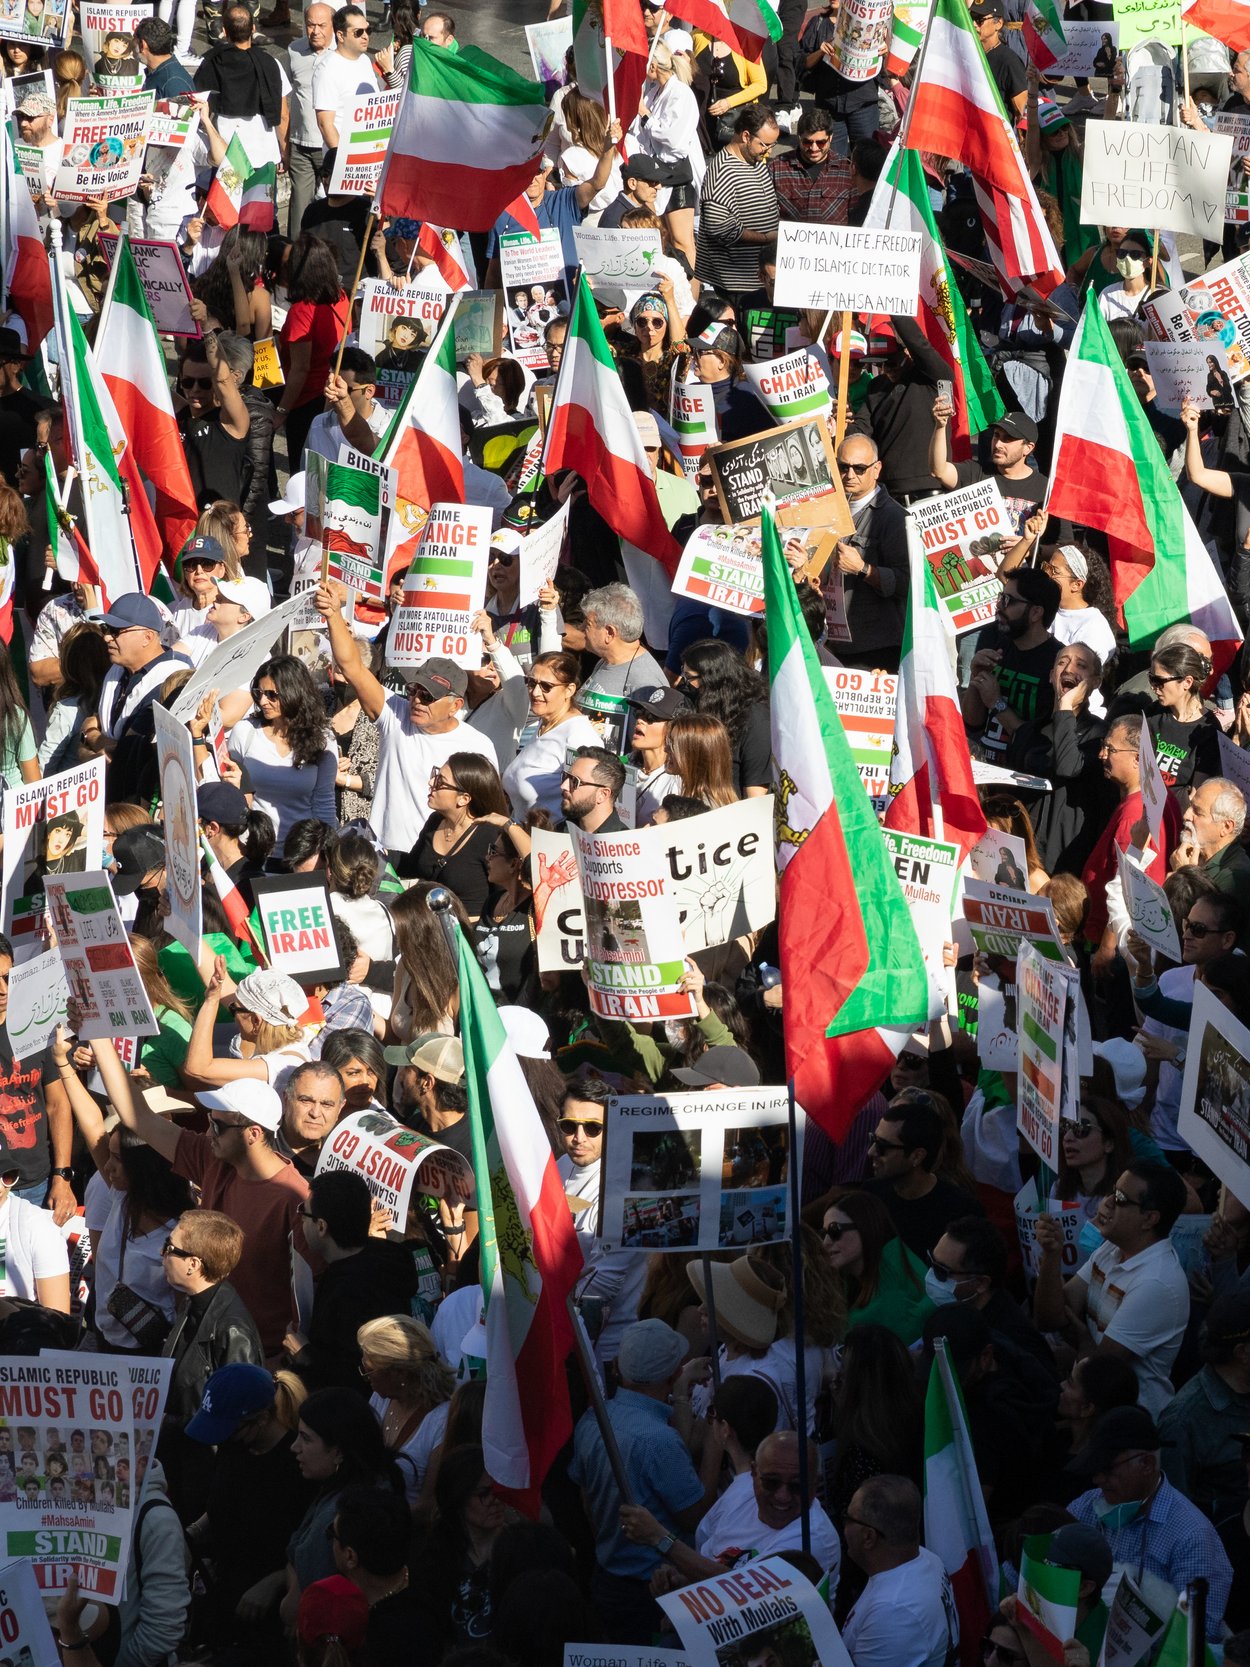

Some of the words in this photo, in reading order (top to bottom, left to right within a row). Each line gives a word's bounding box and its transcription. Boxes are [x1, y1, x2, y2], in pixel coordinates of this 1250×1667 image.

[87, 7, 112, 17] ISLAMIC
[115, 8, 148, 17] REPUBLIC
[87, 15, 126, 31] MUST
[99, 75, 137, 87] STAND
[72, 126, 107, 144] FREE
[108, 120, 145, 138] TOOMAJ
[1103, 129, 1210, 170] WOMAN
[76, 168, 89, 181] Be
[91, 166, 105, 180] His
[107, 162, 129, 177] Voice
[1124, 160, 1180, 187] LIFE
[1092, 181, 1196, 218] FREDOM
[604, 234, 618, 242] Life.
[875, 235, 921, 260] FREEDOM
[780, 256, 795, 276] NO
[798, 256, 812, 276] TO
[813, 257, 860, 274] ISLAMIC
[862, 259, 911, 278] DICTATOR
[374, 285, 403, 298] ISLAMIC
[406, 289, 442, 302] REPUBLIC
[1208, 276, 1245, 320] FREE
[370, 295, 416, 317] MUST
[421, 300, 443, 321] GO
[760, 358, 824, 396] CHANGE
[771, 354, 809, 376] REGIME
[779, 394, 785, 404] in
[793, 383, 816, 399] IRAN
[728, 467, 763, 488] STAND
[920, 499, 945, 519] MORE
[944, 483, 994, 510] AYATOLLAHS
[953, 495, 994, 522] REPUBLIC
[920, 522, 968, 554] MUST
[976, 508, 1000, 530] GO
[188, 538, 212, 551] USA
[427, 544, 458, 558] IRAN
[706, 538, 730, 555] Children
[729, 544, 746, 560] Killed
[340, 557, 371, 579] STAND
[717, 554, 758, 574] #MahsaAmini
[341, 570, 367, 590] IRAN
[708, 562, 764, 592] STAND
[707, 582, 754, 609] IRAN
[397, 621, 423, 632] ISLAMIC
[425, 622, 469, 635] REPUBLIC
[423, 611, 470, 624] AYATOLLAHS
[394, 632, 435, 653] MUST
[442, 635, 468, 656] GO
[836, 673, 863, 691] GO
[835, 689, 879, 705] REPUBLIC
[16, 783, 54, 806] ISLAMIC
[56, 766, 98, 793] REPUBLIC
[15, 790, 69, 830] MUST
[76, 778, 99, 808] GO
[594, 841, 640, 858] Silence
[901, 840, 955, 867] Freedom.
[584, 857, 623, 876] Supports
[587, 877, 665, 903] Oppressor
[904, 882, 941, 904] Mullahs
[82, 919, 97, 939] LIFE
[267, 905, 326, 934] FREE
[981, 903, 1031, 931] IRAN
[271, 928, 330, 954] IRAN
[593, 963, 662, 987] STAND
[599, 994, 661, 1019] IRAN
[1025, 965, 1060, 1028] CHANGE
[108, 1011, 127, 1027] IRAN
[130, 1009, 150, 1025] IRAN
[619, 1104, 679, 1118] REGIME
[682, 1101, 748, 1115] CHANGE
[751, 1100, 766, 1111] IN
[1021, 1103, 1040, 1145] MUST
[1041, 1130, 1053, 1162] GO
[332, 1128, 361, 1158] GO
[356, 1149, 409, 1193] MUST
[56, 1370, 119, 1388] REPUBLIC
[0, 1385, 78, 1419] MUST
[90, 1387, 124, 1422] GO
[133, 1386, 159, 1421] GO
[202, 1389, 213, 1413] LA
[16, 1496, 53, 1510] Children
[89, 1499, 115, 1514] Mullahs
[41, 1514, 96, 1529] #MahsaAmini
[34, 1530, 108, 1557] STAND
[39, 1556, 70, 1566] Solidarity
[71, 1557, 82, 1566] with
[45, 1563, 99, 1590] IRAN
[679, 1584, 726, 1625] NO
[716, 1563, 793, 1607] DEAL
[705, 1609, 744, 1646] With
[739, 1593, 799, 1635] Mullahs
